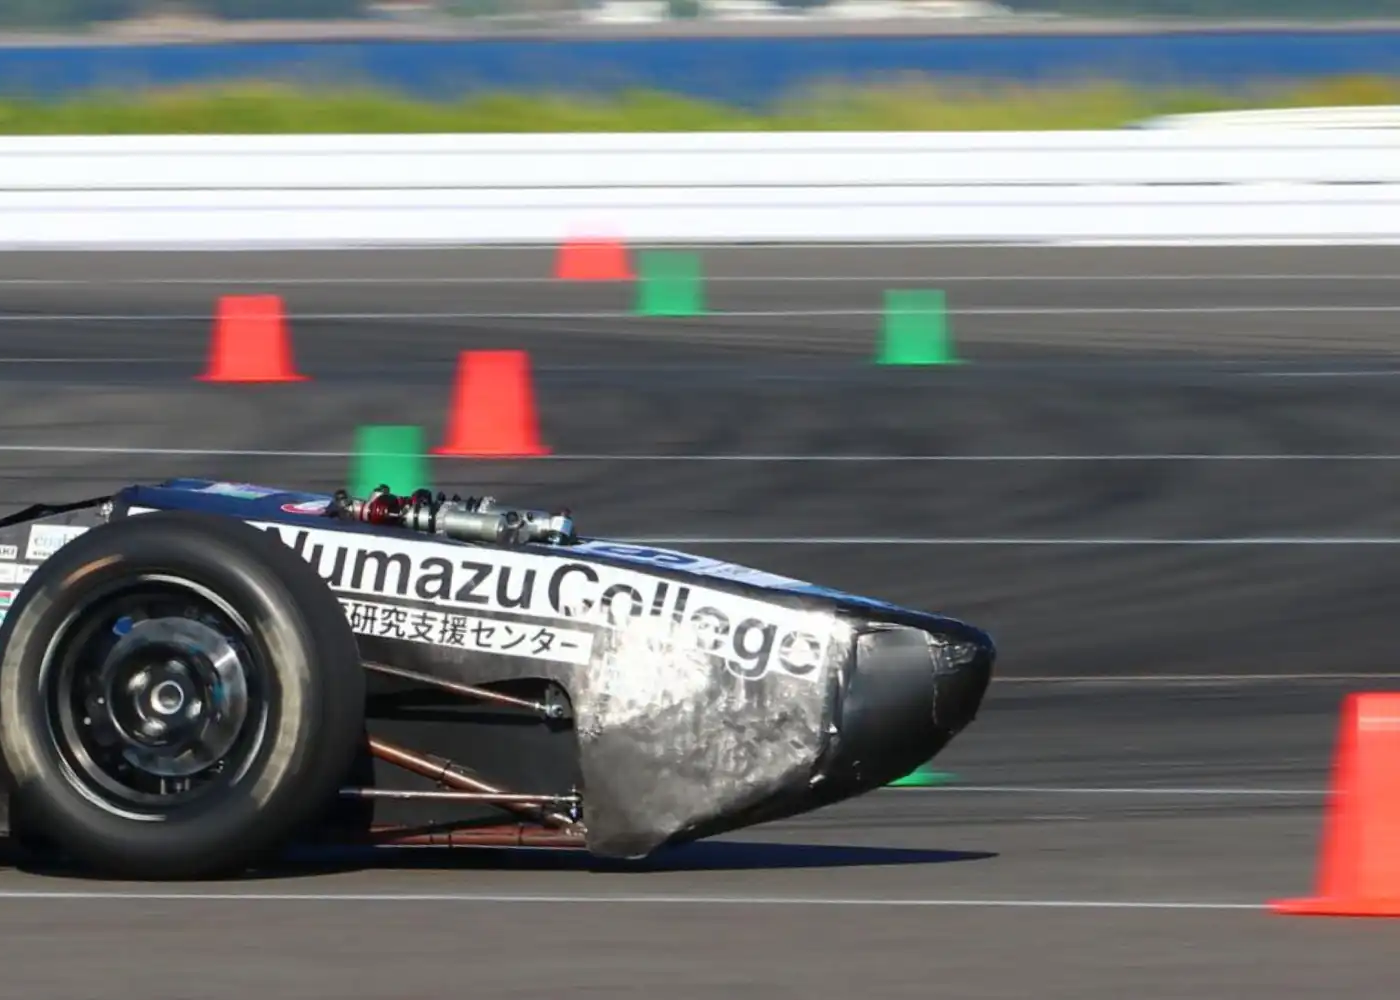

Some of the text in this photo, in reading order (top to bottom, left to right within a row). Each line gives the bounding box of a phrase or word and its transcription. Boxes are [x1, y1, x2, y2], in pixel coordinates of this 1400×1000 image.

[340, 602, 579, 655] 研究支援センター
[547, 562, 823, 677] College
